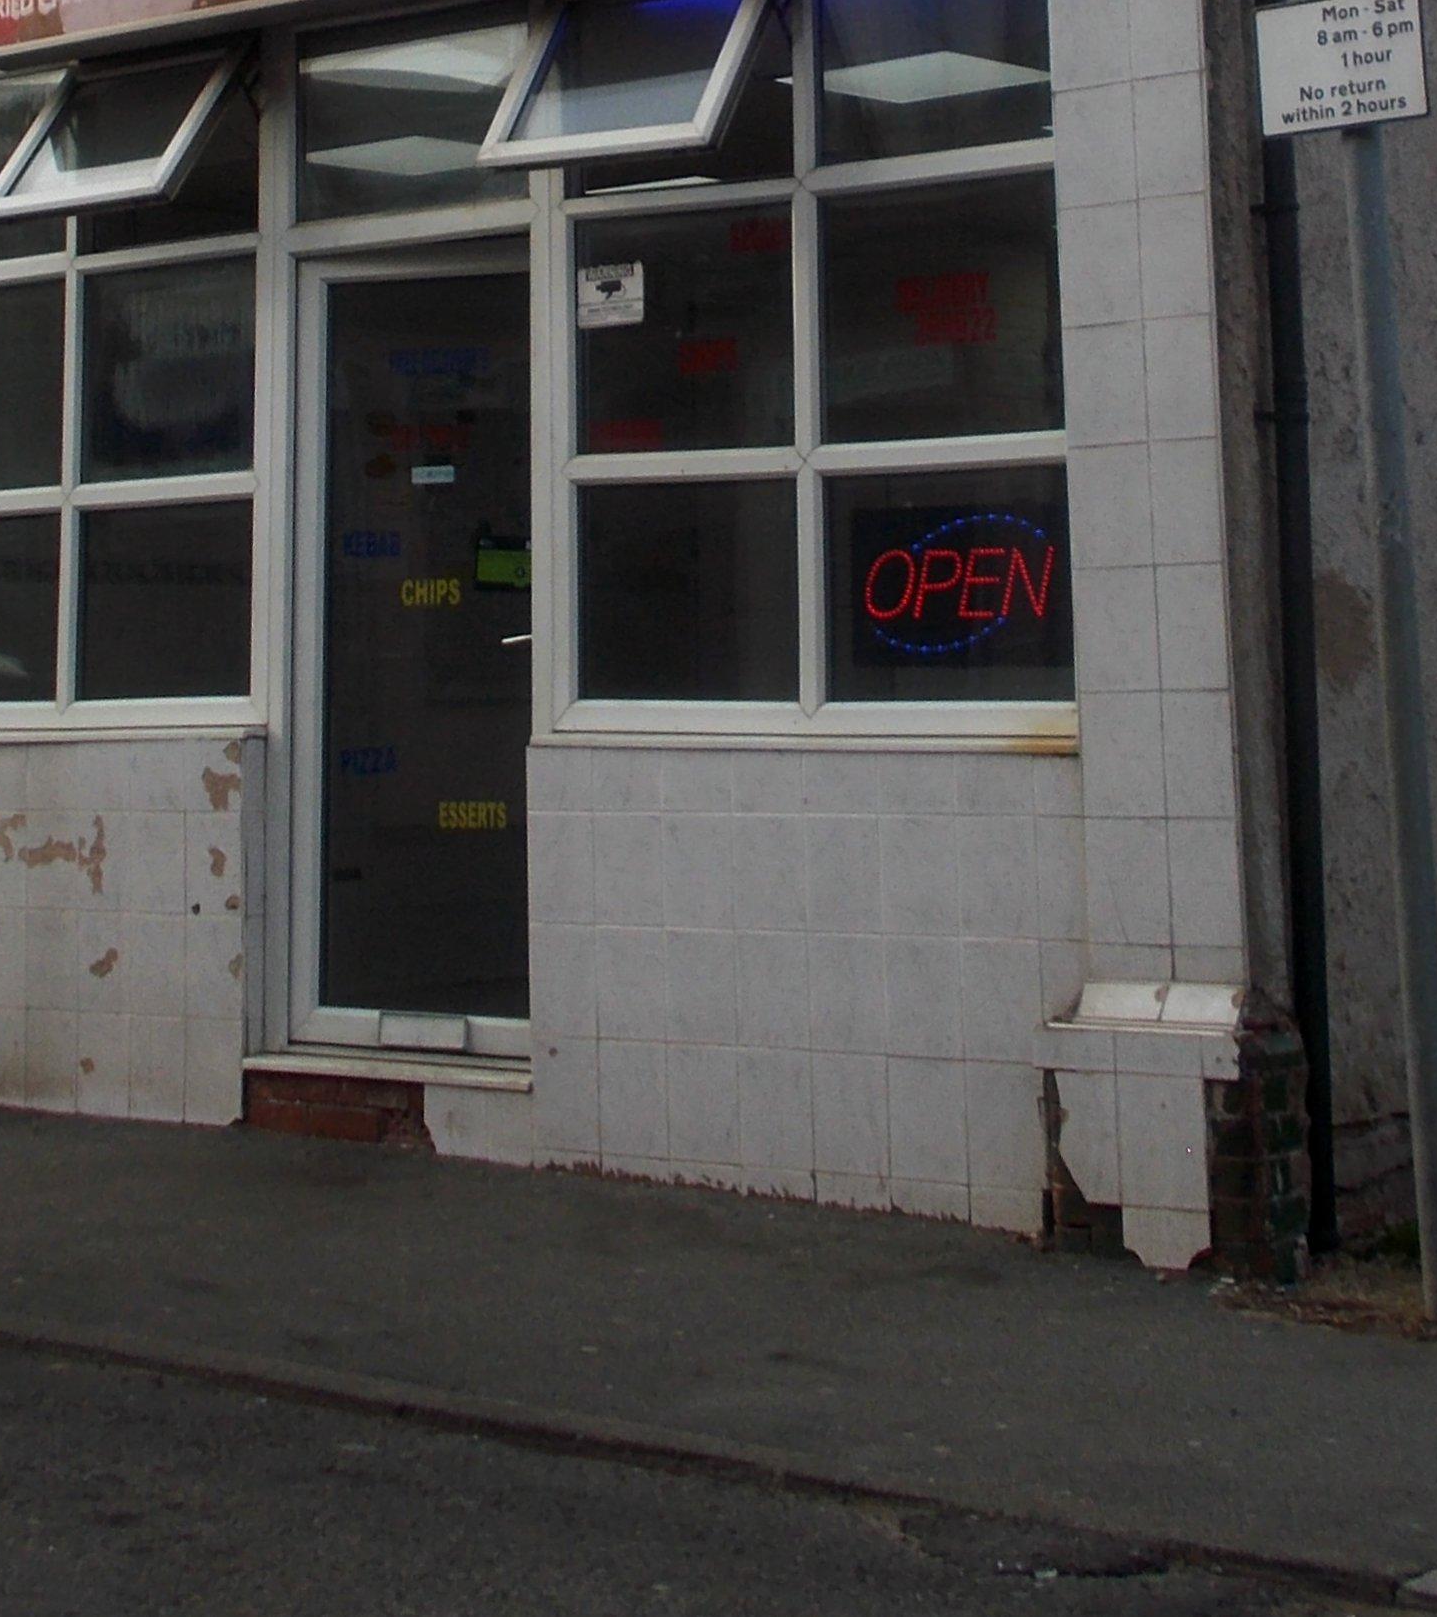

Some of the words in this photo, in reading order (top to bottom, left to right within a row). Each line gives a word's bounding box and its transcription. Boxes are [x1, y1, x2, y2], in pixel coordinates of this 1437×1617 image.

[1322, 5, 1359, 22] Mon
[1317, 29, 1328, 46] 8
[1332, 28, 1359, 44] am
[1372, 21, 1383, 38] 6
[1387, 19, 1414, 39] pm
[1341, 52, 1348, 68] 1
[1353, 48, 1393, 66] hour
[1299, 85, 1325, 102] No
[1330, 78, 1387, 99] return
[1281, 105, 1336, 125] within
[1341, 100, 1353, 117] 2
[1356, 96, 1408, 115] hours
[400, 579, 461, 605] CHIPS
[865, 545, 1057, 621] OPEN
[438, 801, 507, 828] ESSERTS
